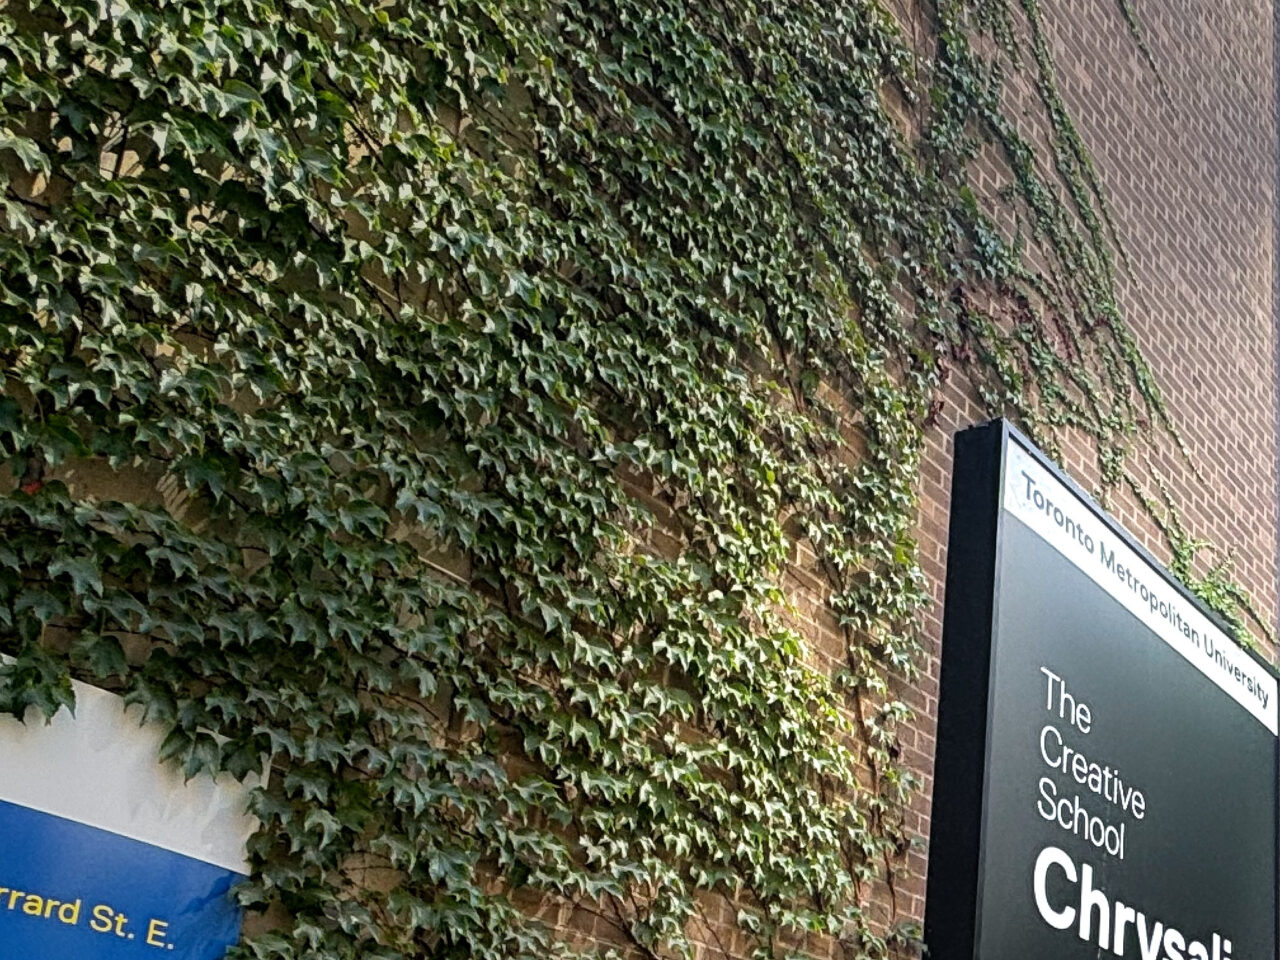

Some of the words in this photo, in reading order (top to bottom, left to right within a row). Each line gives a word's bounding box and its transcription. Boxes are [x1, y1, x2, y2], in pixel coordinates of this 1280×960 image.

[1021, 470, 1095, 554] Toronto
[1100, 541, 1200, 648] Metropolitan
[1204, 634, 1269, 709] University
[1040, 666, 1091, 735] The
[1040, 724, 1146, 820] Creative
[1037, 776, 1125, 860] School
[90, 904, 134, 939] St.
[146, 918, 174, 950] E.
